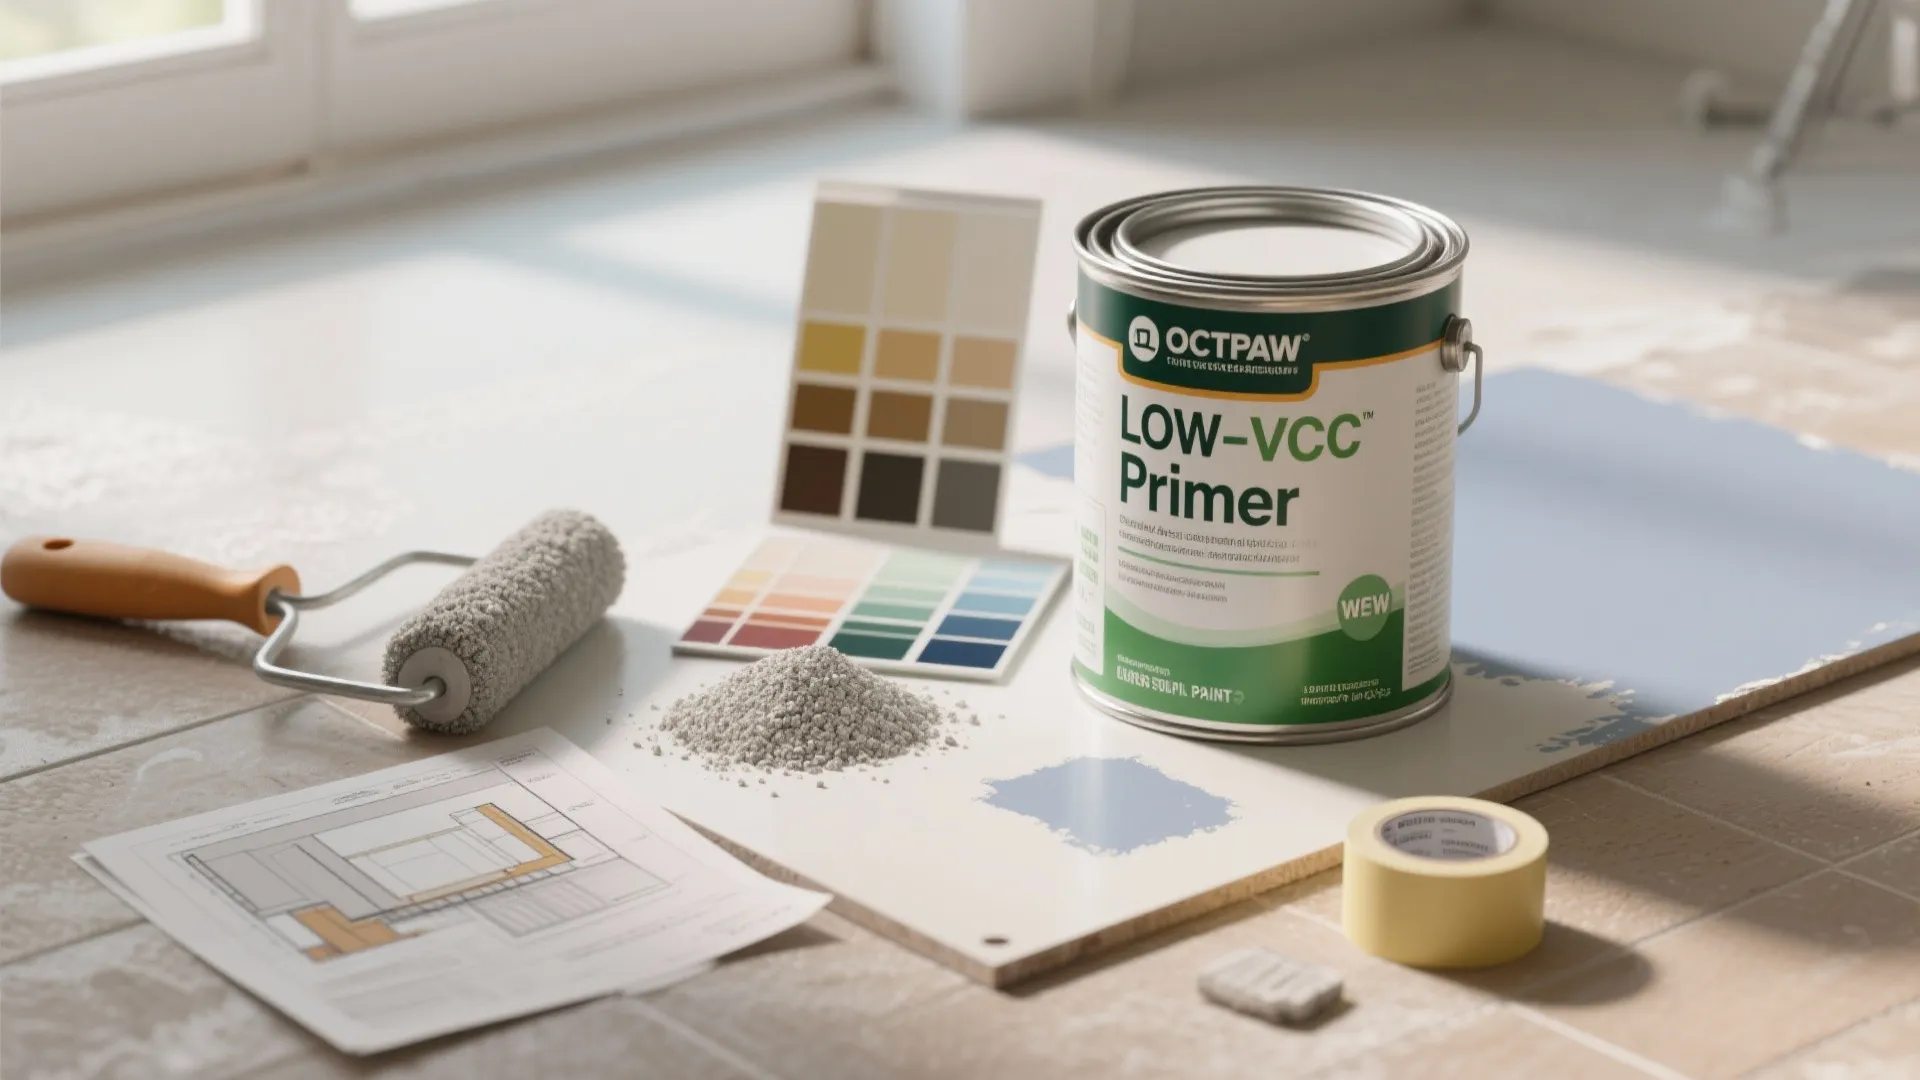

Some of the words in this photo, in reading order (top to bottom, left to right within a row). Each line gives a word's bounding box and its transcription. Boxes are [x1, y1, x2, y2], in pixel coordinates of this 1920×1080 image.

[1120, 451, 1300, 526] Primer
[1341, 592, 1390, 620] WEW
[1191, 684, 1233, 703] PAINT
